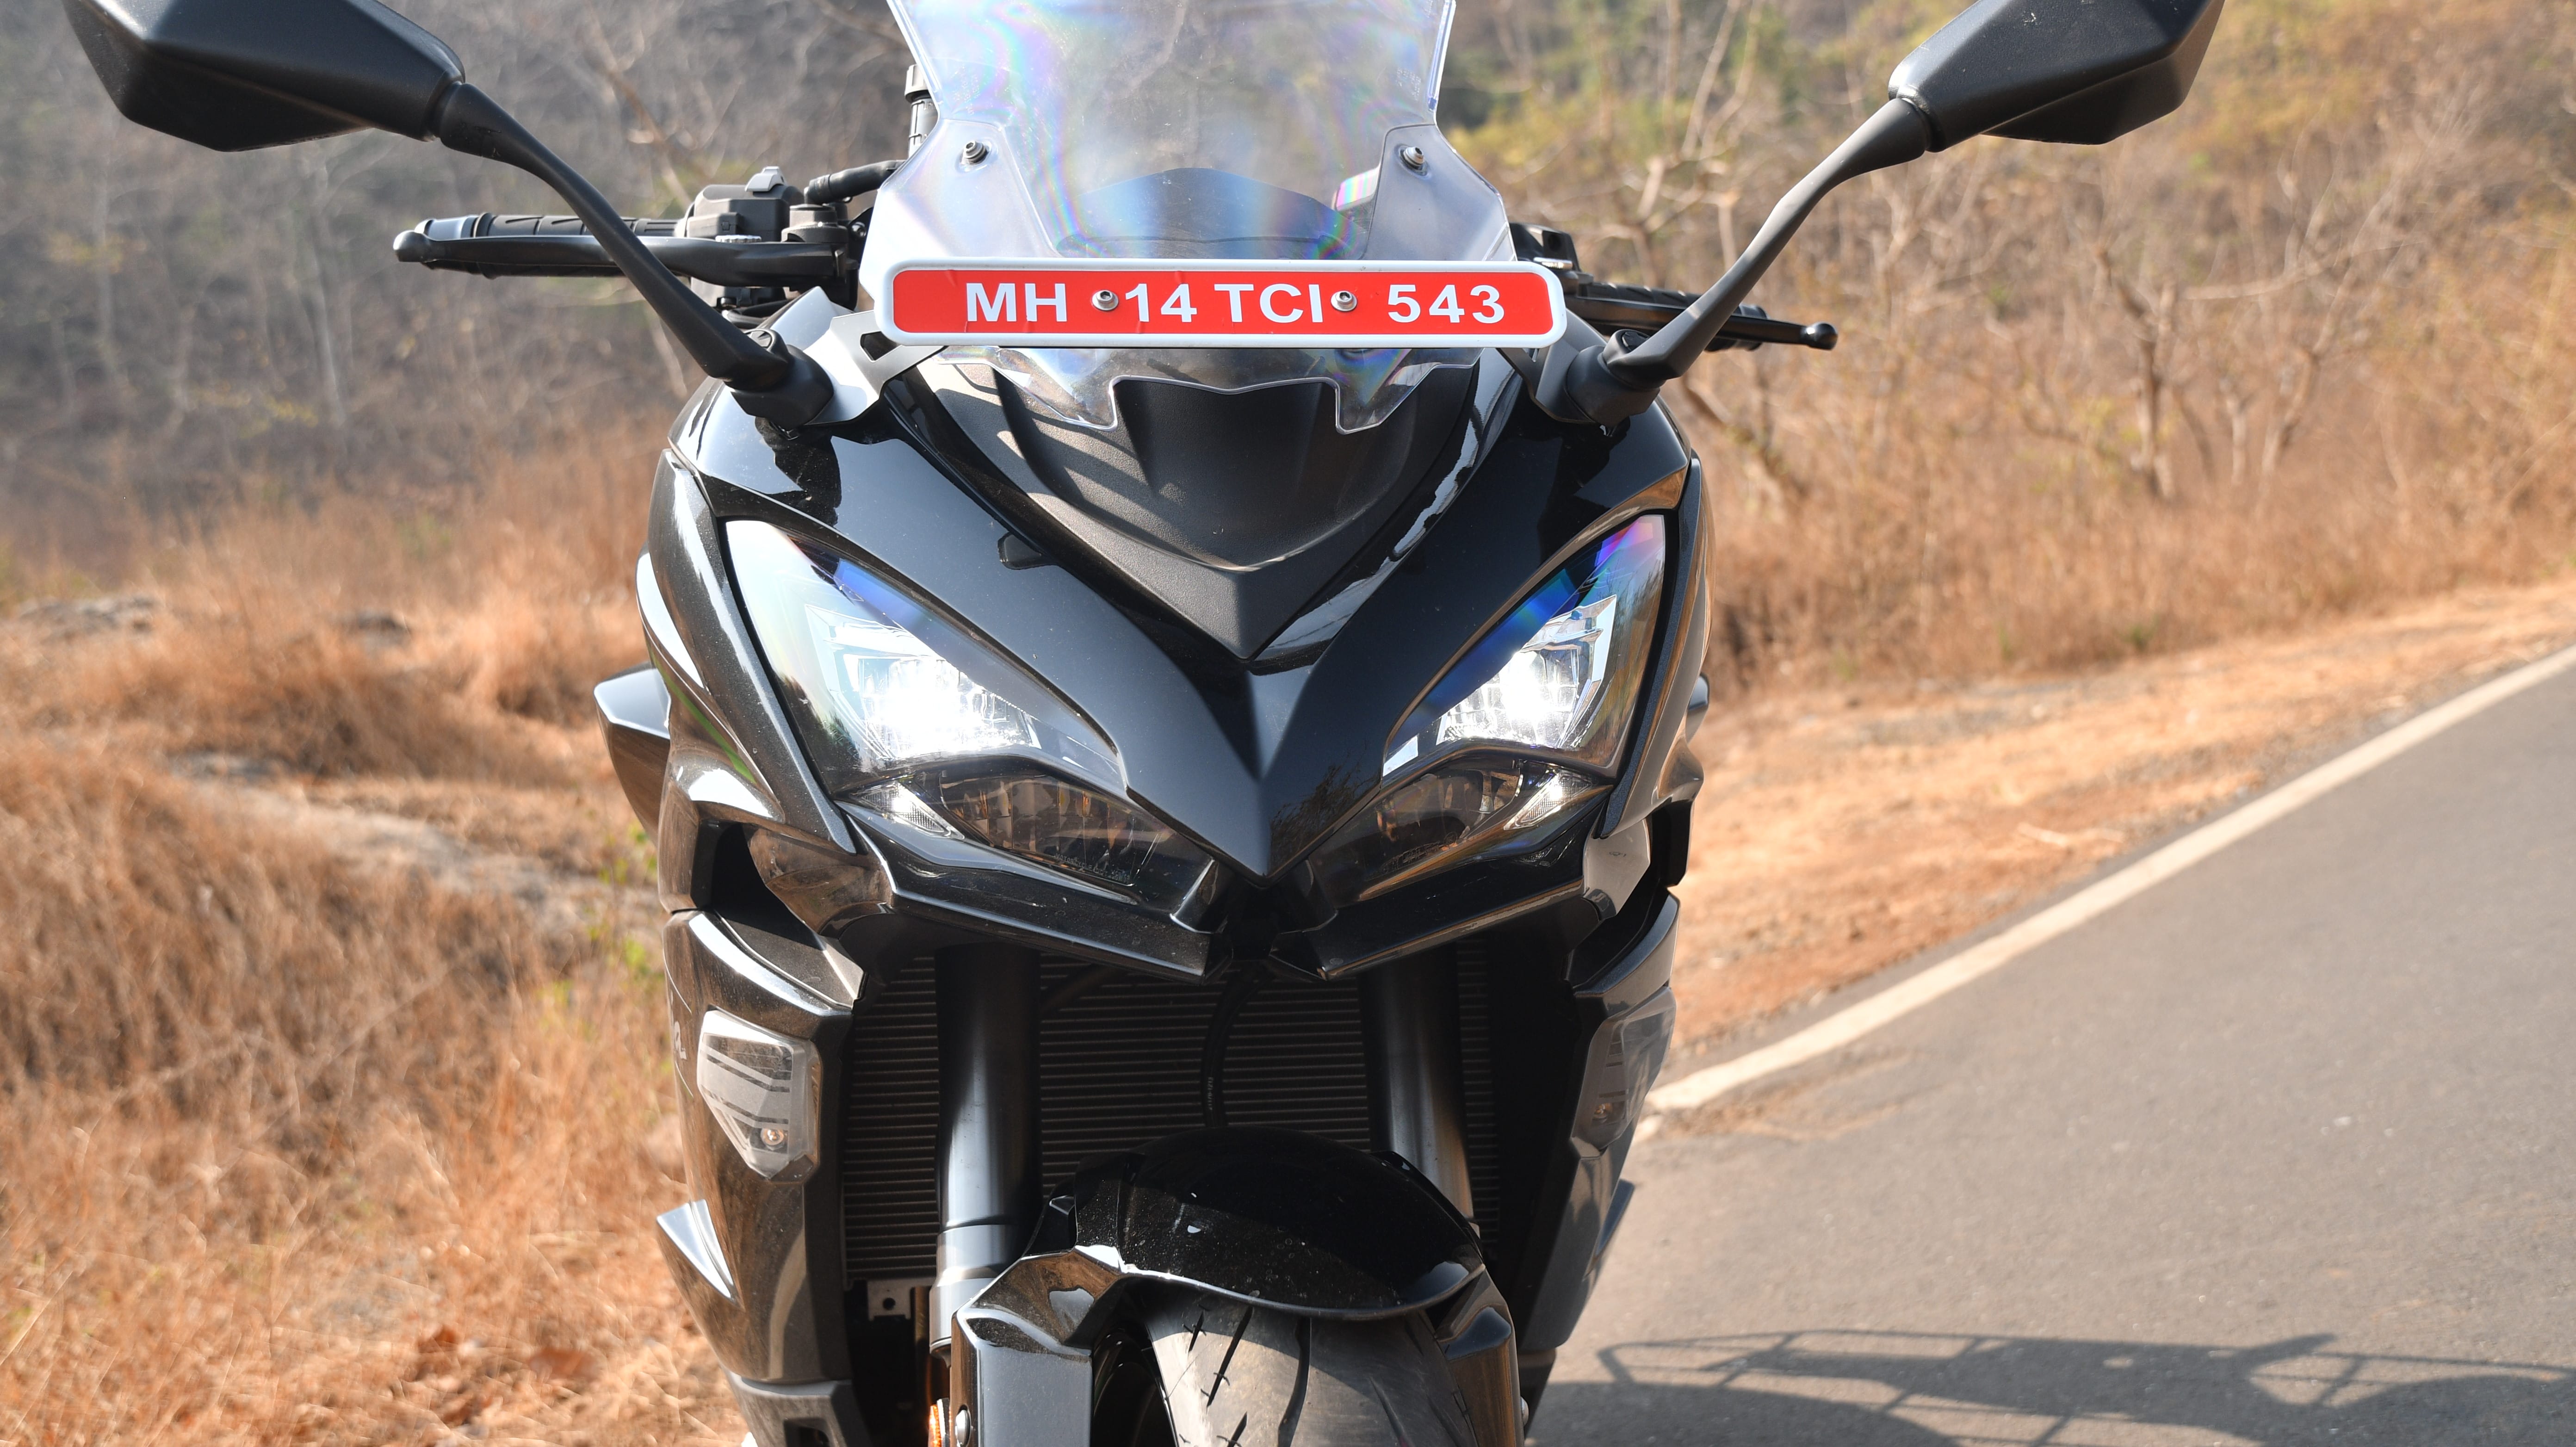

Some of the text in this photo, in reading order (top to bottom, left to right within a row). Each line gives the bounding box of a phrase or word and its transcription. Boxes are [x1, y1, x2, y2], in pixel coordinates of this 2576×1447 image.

[966, 283, 1505, 324] MH 14 TCI 543
